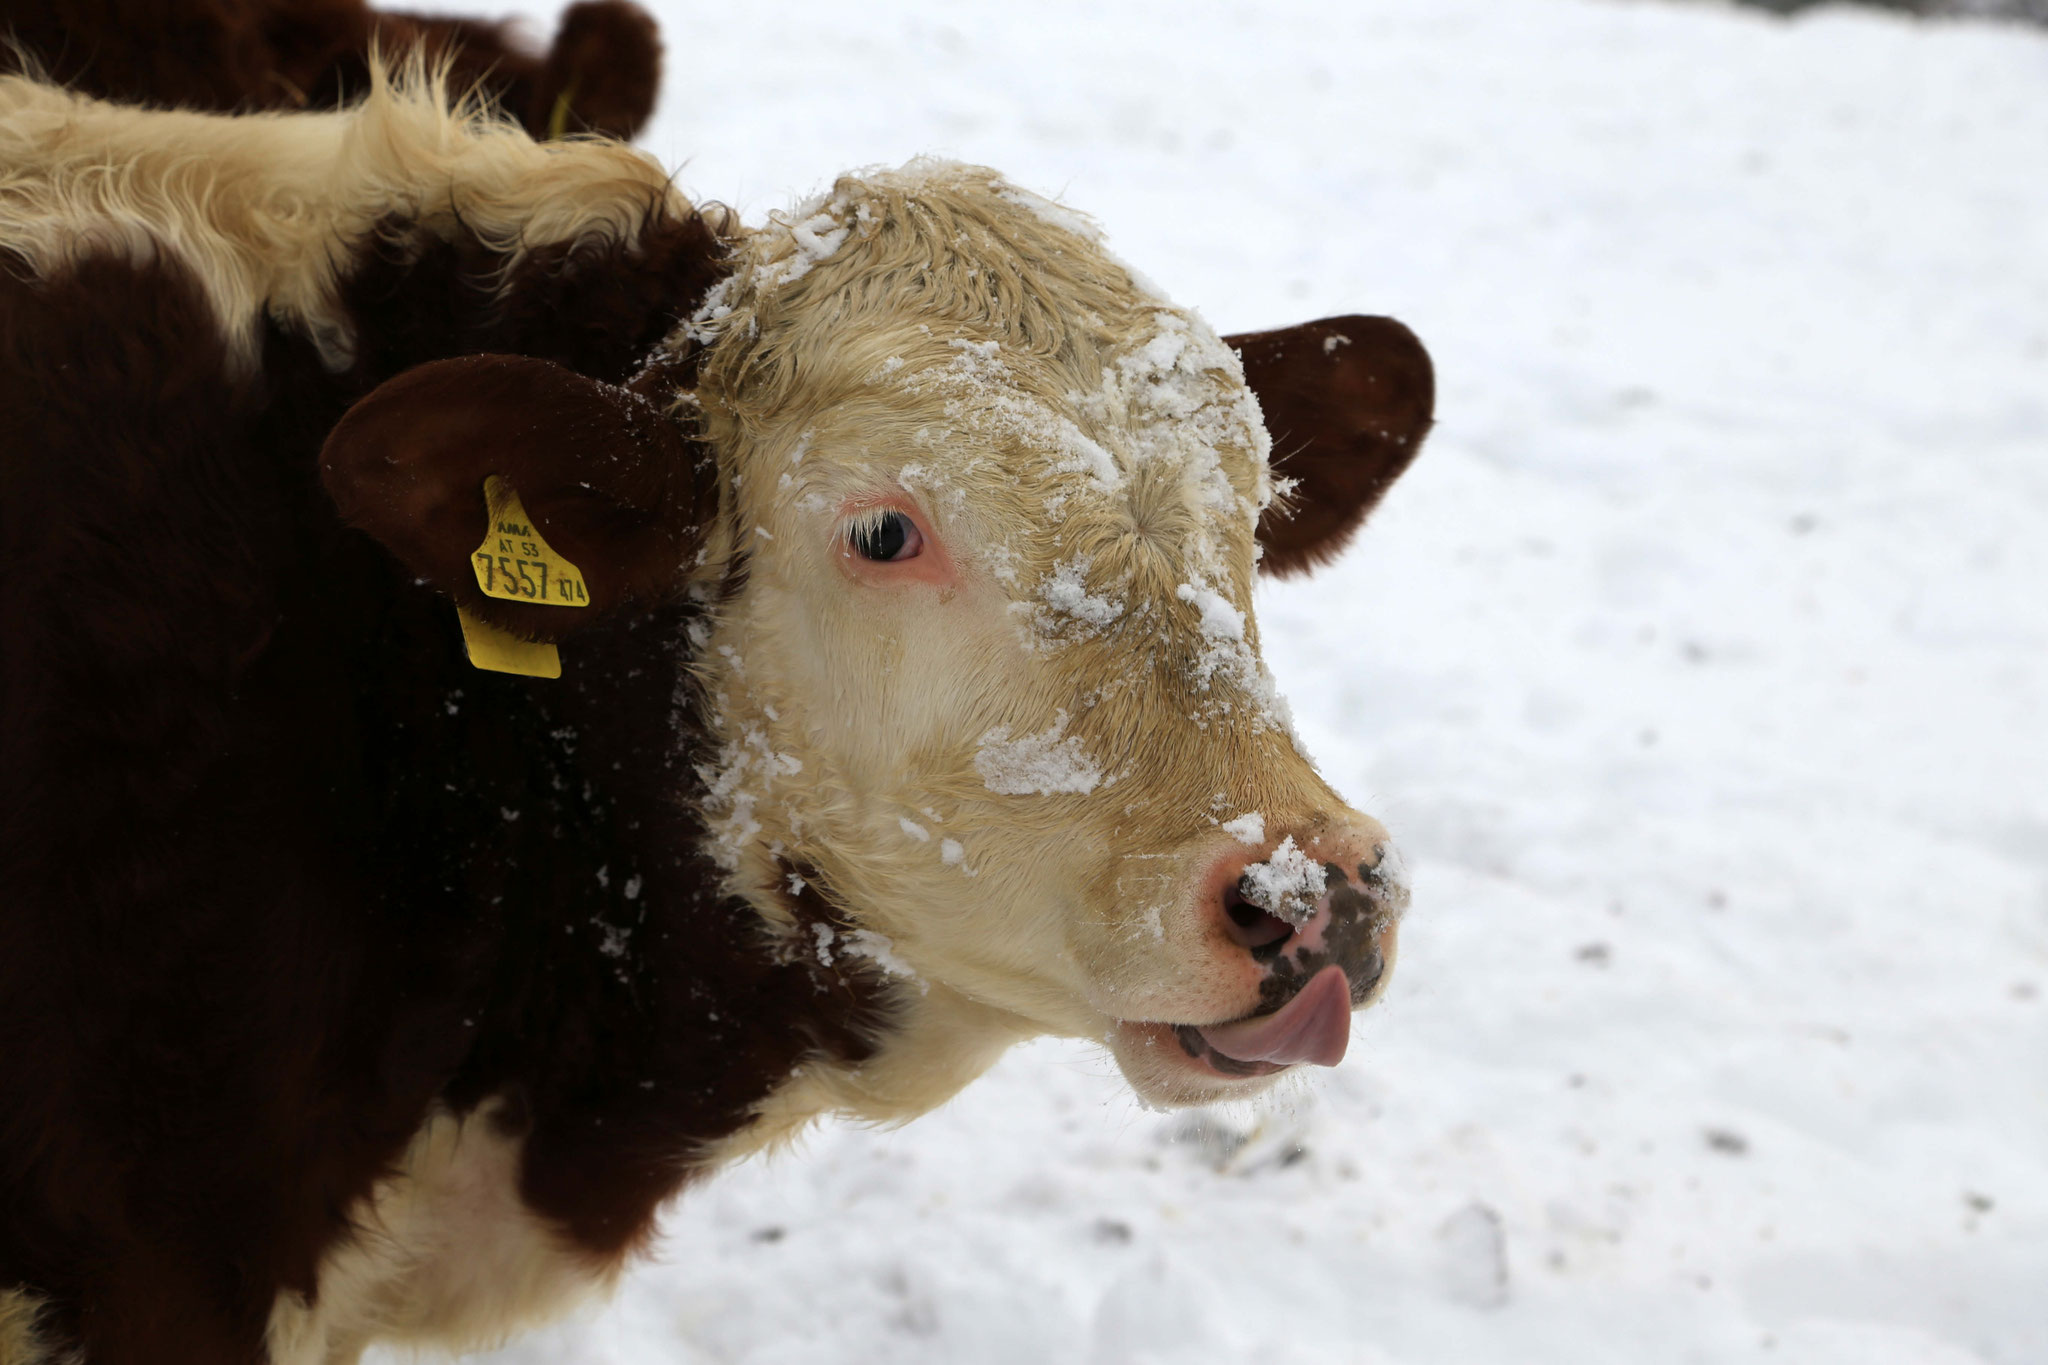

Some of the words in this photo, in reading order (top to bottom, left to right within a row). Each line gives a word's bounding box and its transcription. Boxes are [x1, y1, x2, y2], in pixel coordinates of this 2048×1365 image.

[499, 538, 514, 553] AT
[521, 542, 539, 557] 53
[477, 552, 547, 600] 7557
[560, 578, 586, 602] 474
